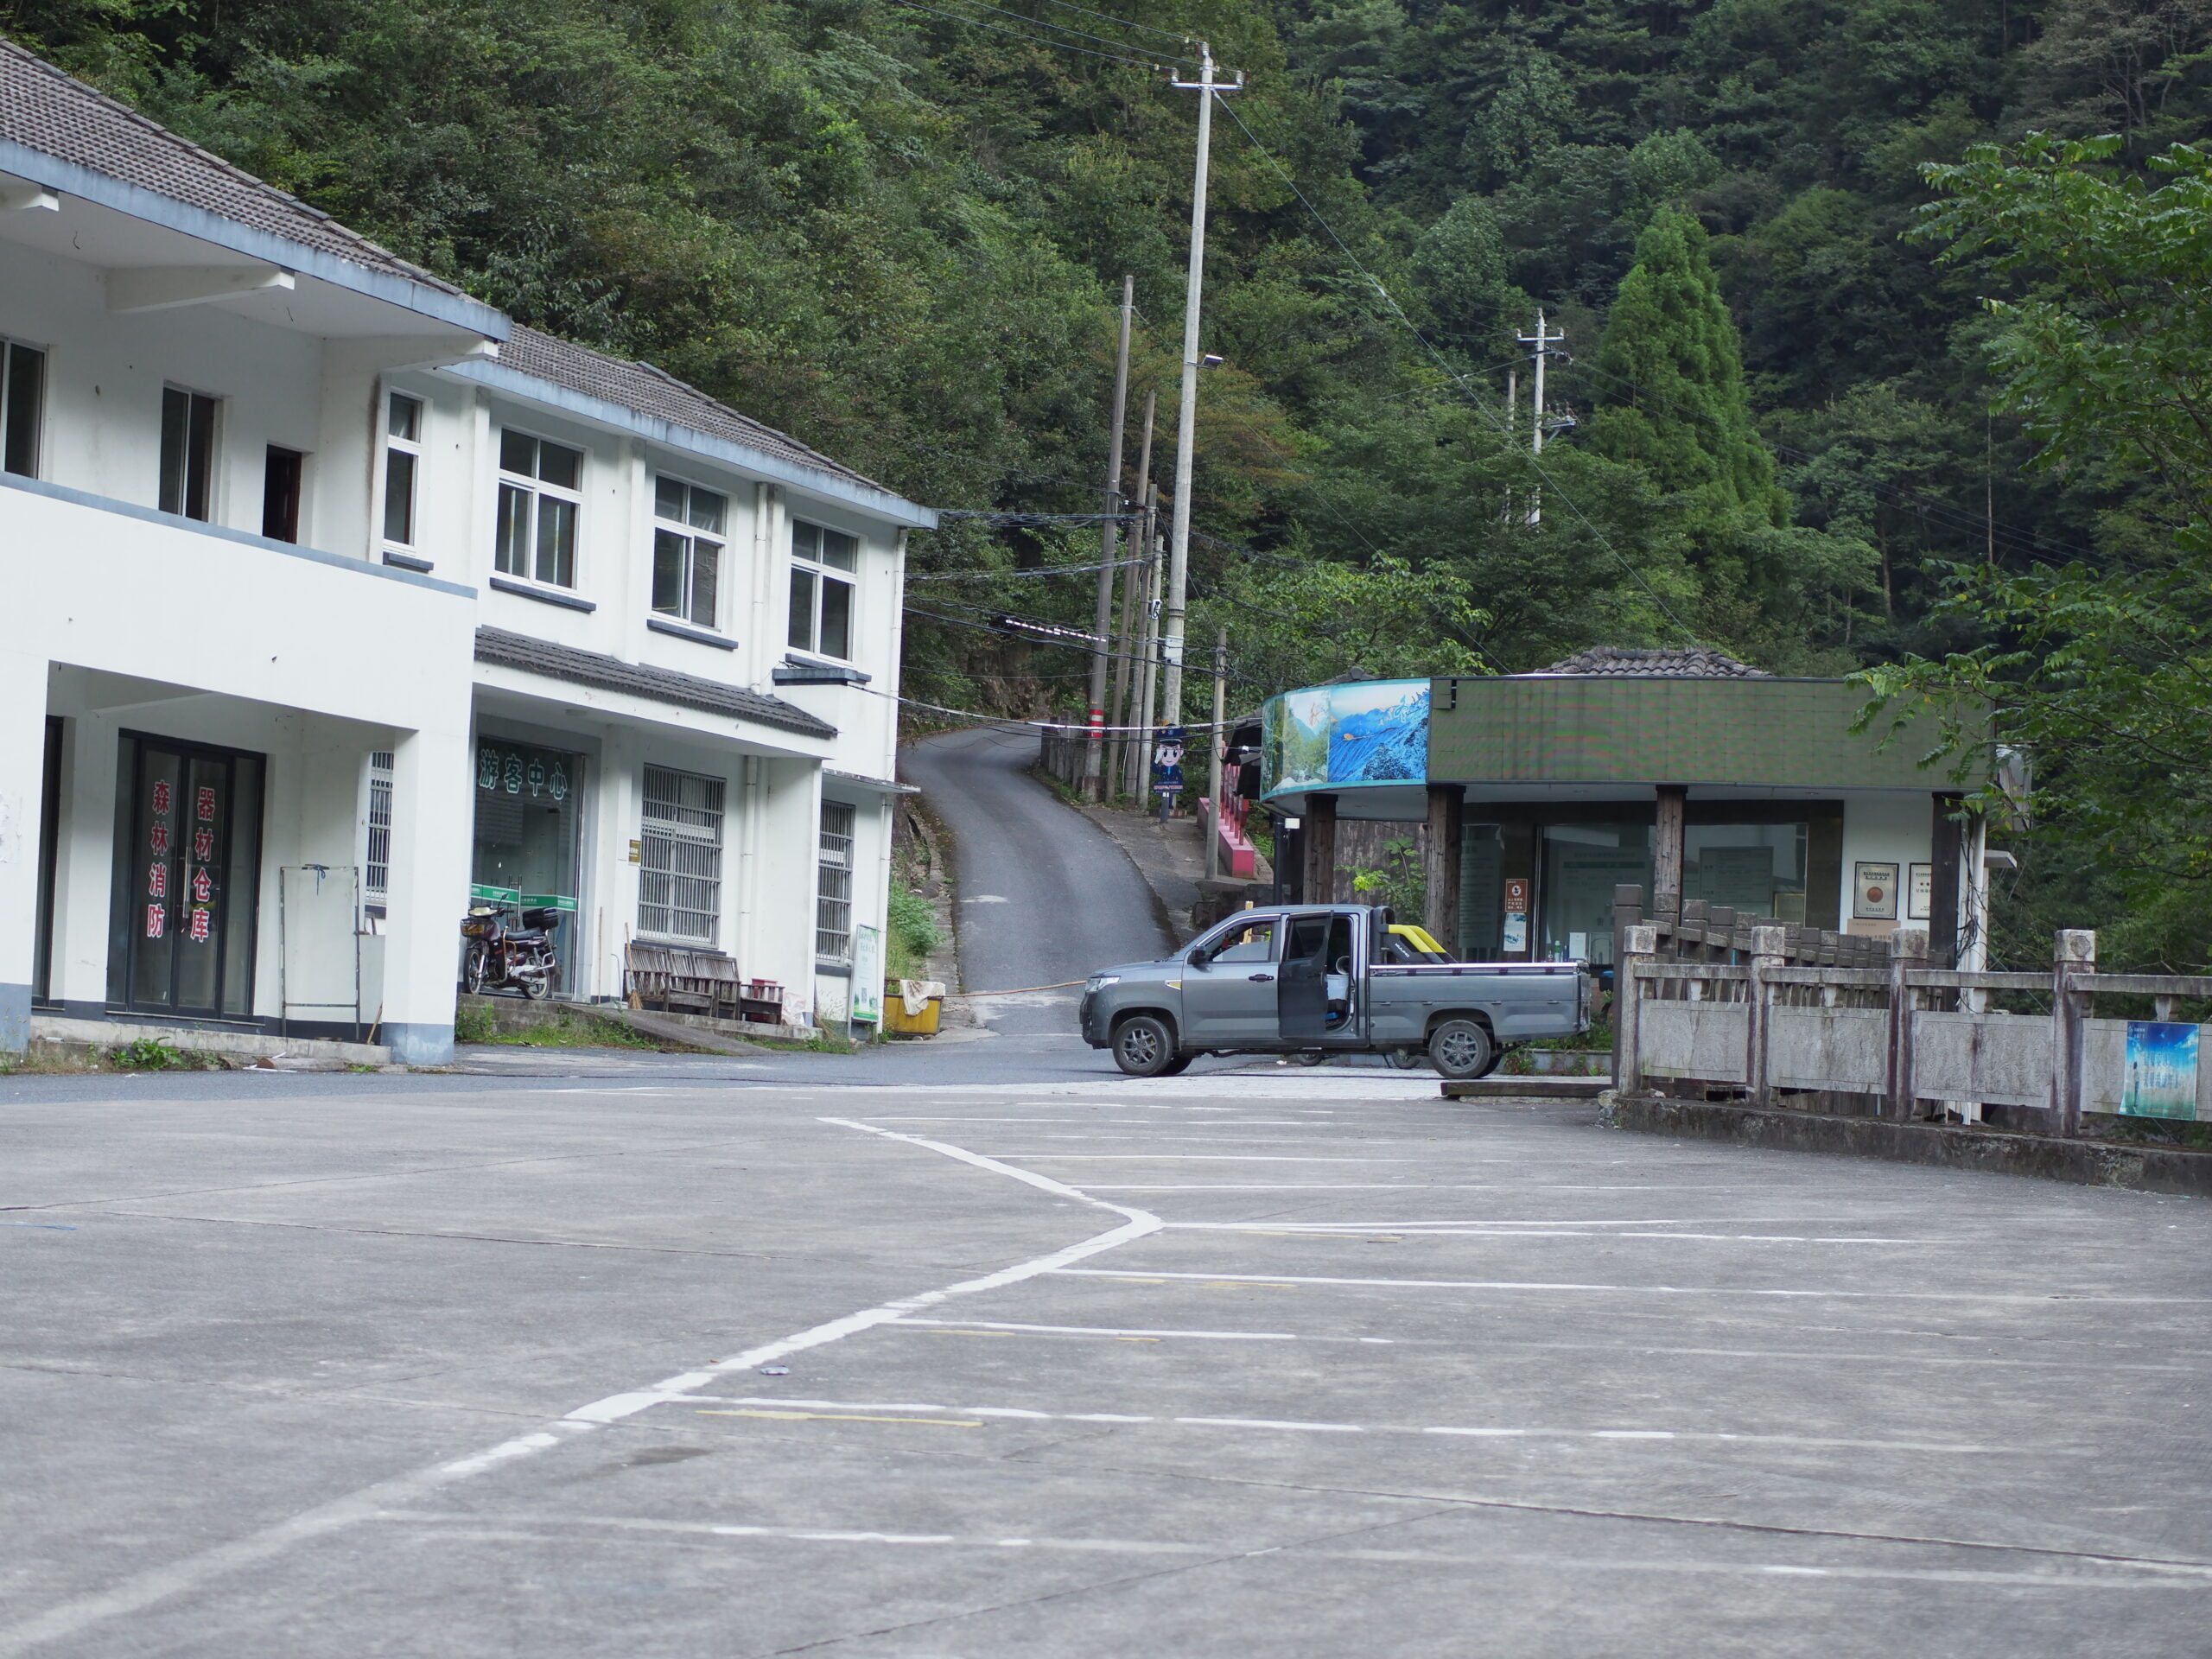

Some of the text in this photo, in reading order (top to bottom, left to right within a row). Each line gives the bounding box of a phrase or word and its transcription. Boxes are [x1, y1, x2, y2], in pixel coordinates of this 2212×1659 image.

[479, 748, 567, 801] 游客中心
[146, 779, 171, 938] 森林消防
[189, 786, 215, 943] 器材仓库
